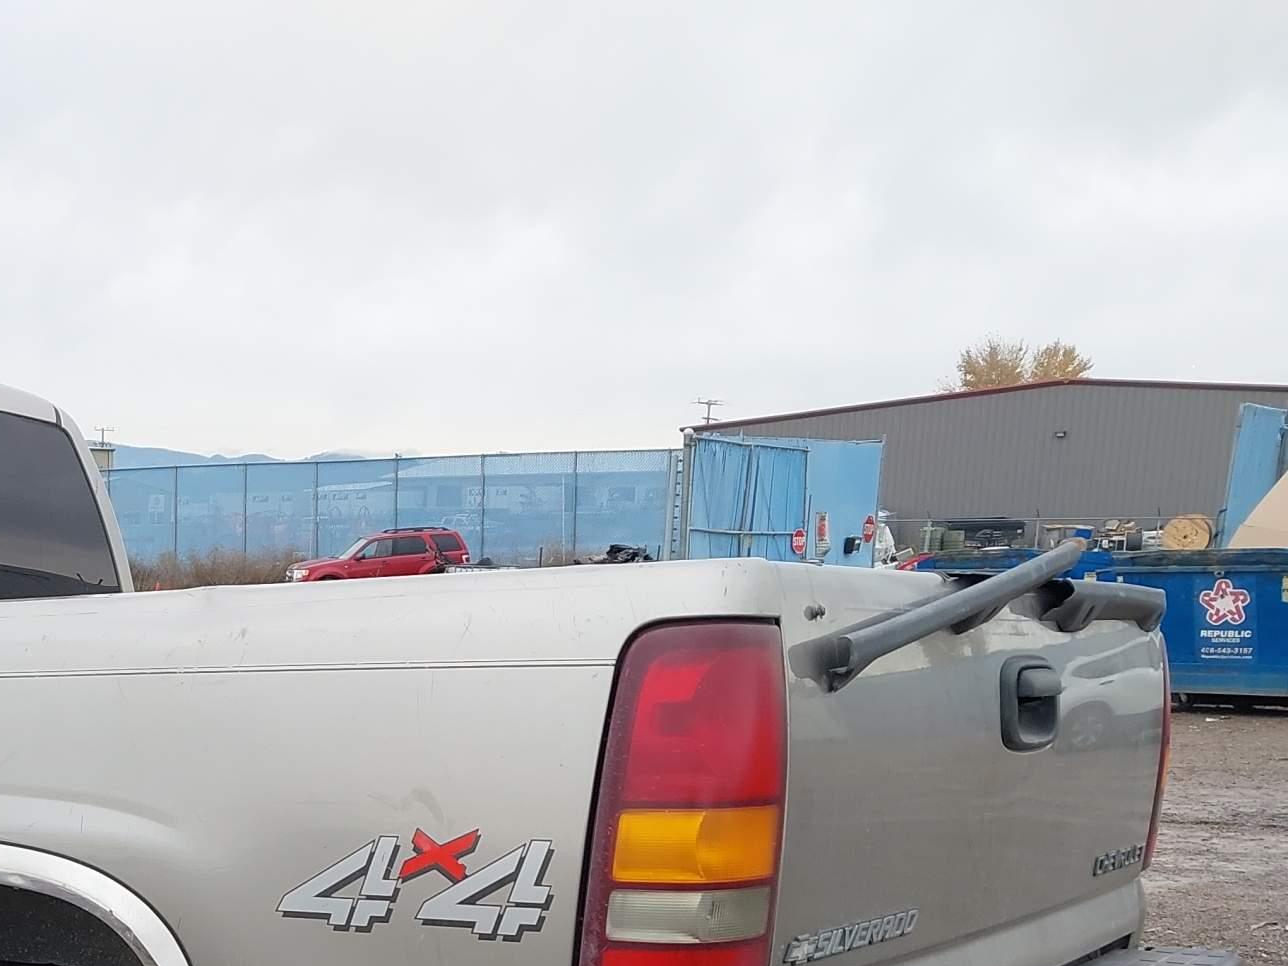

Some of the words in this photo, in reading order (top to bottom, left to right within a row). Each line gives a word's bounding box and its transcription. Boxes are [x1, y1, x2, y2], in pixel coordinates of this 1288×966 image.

[793, 536, 806, 546] STOP
[1200, 629, 1252, 638] REPUBLIC
[813, 906, 919, 960] SILVERADO
